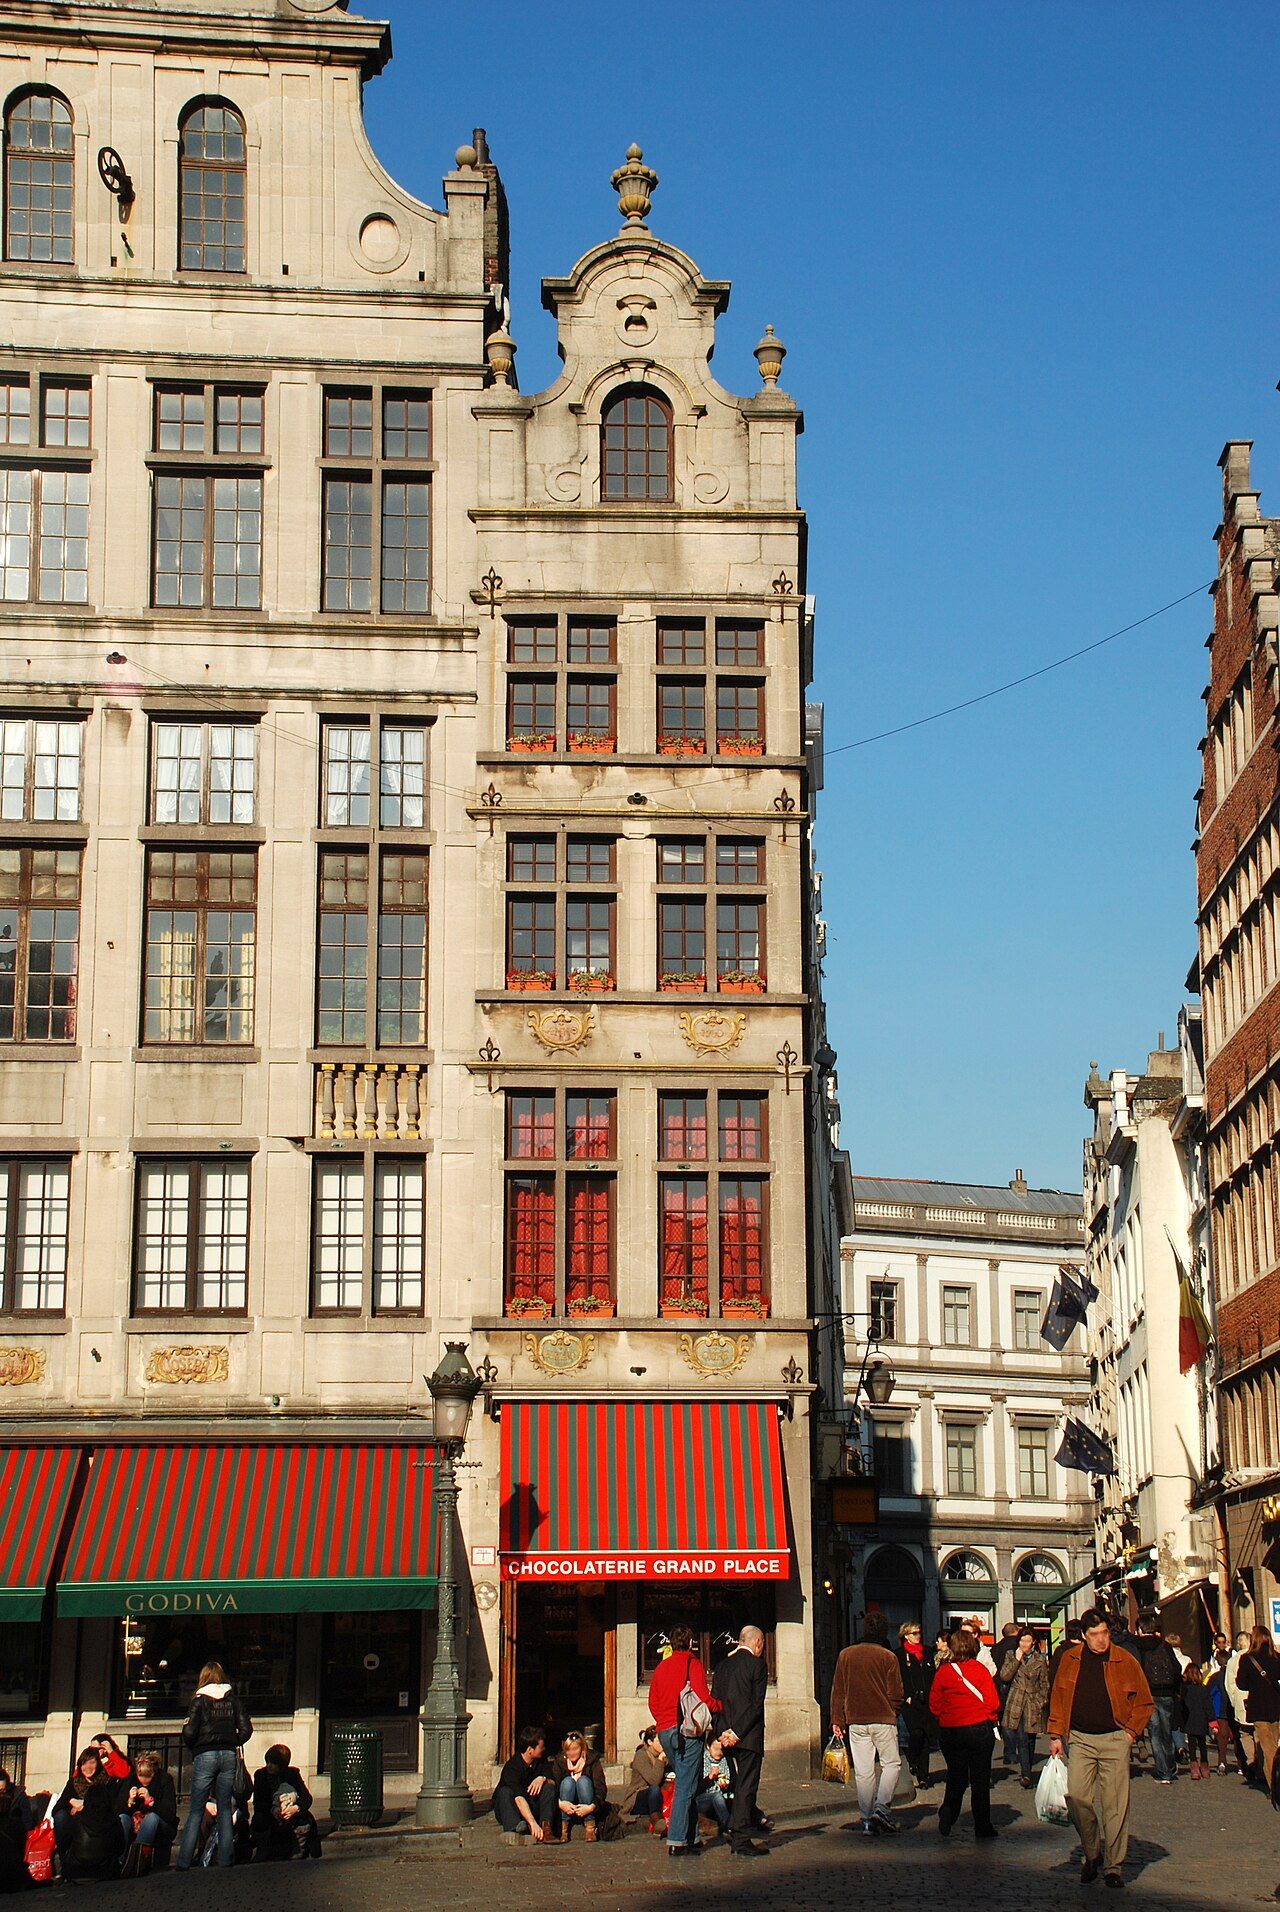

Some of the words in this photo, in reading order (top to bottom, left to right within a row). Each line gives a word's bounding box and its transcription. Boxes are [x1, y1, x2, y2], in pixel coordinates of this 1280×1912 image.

[508, 1560, 647, 1575] CHOCOLATERIE
[653, 1559, 717, 1574] GRAND
[723, 1559, 780, 1573] PLACE
[125, 1593, 239, 1612] GODIVA
